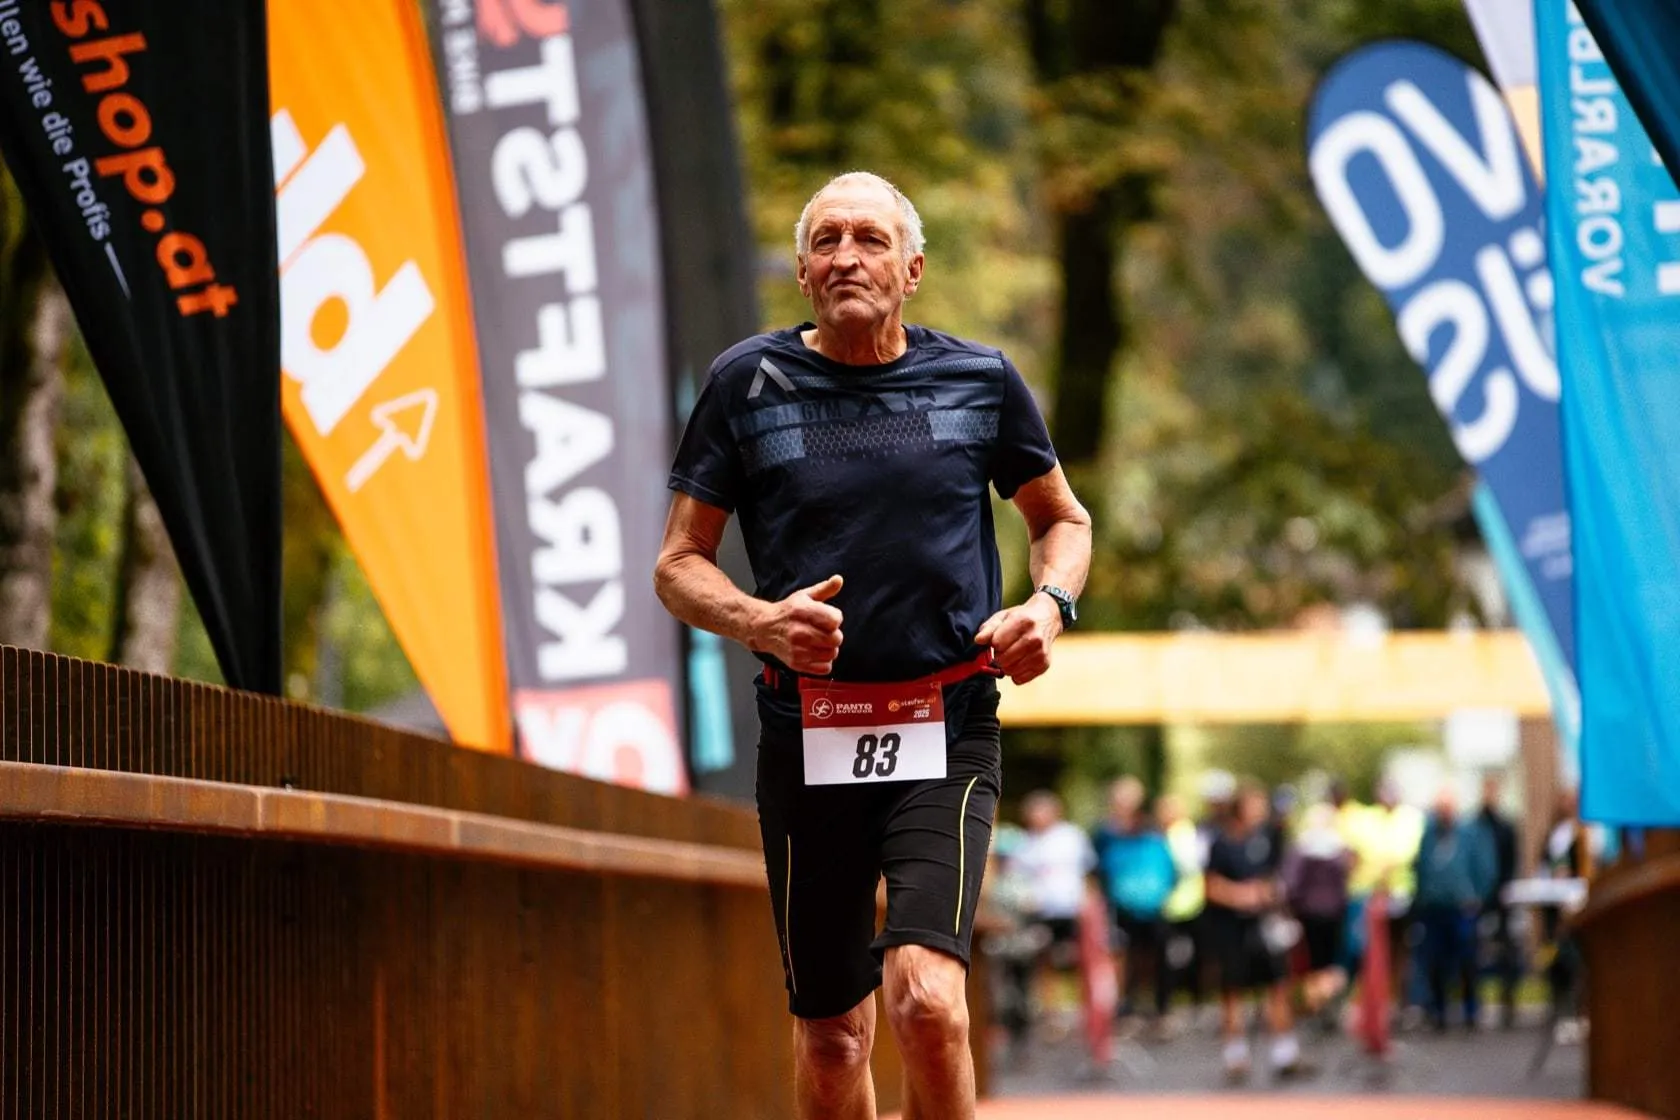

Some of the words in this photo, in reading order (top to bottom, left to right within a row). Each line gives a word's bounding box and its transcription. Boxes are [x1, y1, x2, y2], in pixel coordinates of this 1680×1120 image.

[19, 56, 53, 110] wie
[42, 110, 74, 157] die
[63, 156, 112, 242] Profis
[913, 708, 931, 719] 2025
[852, 732, 901, 778] 83
